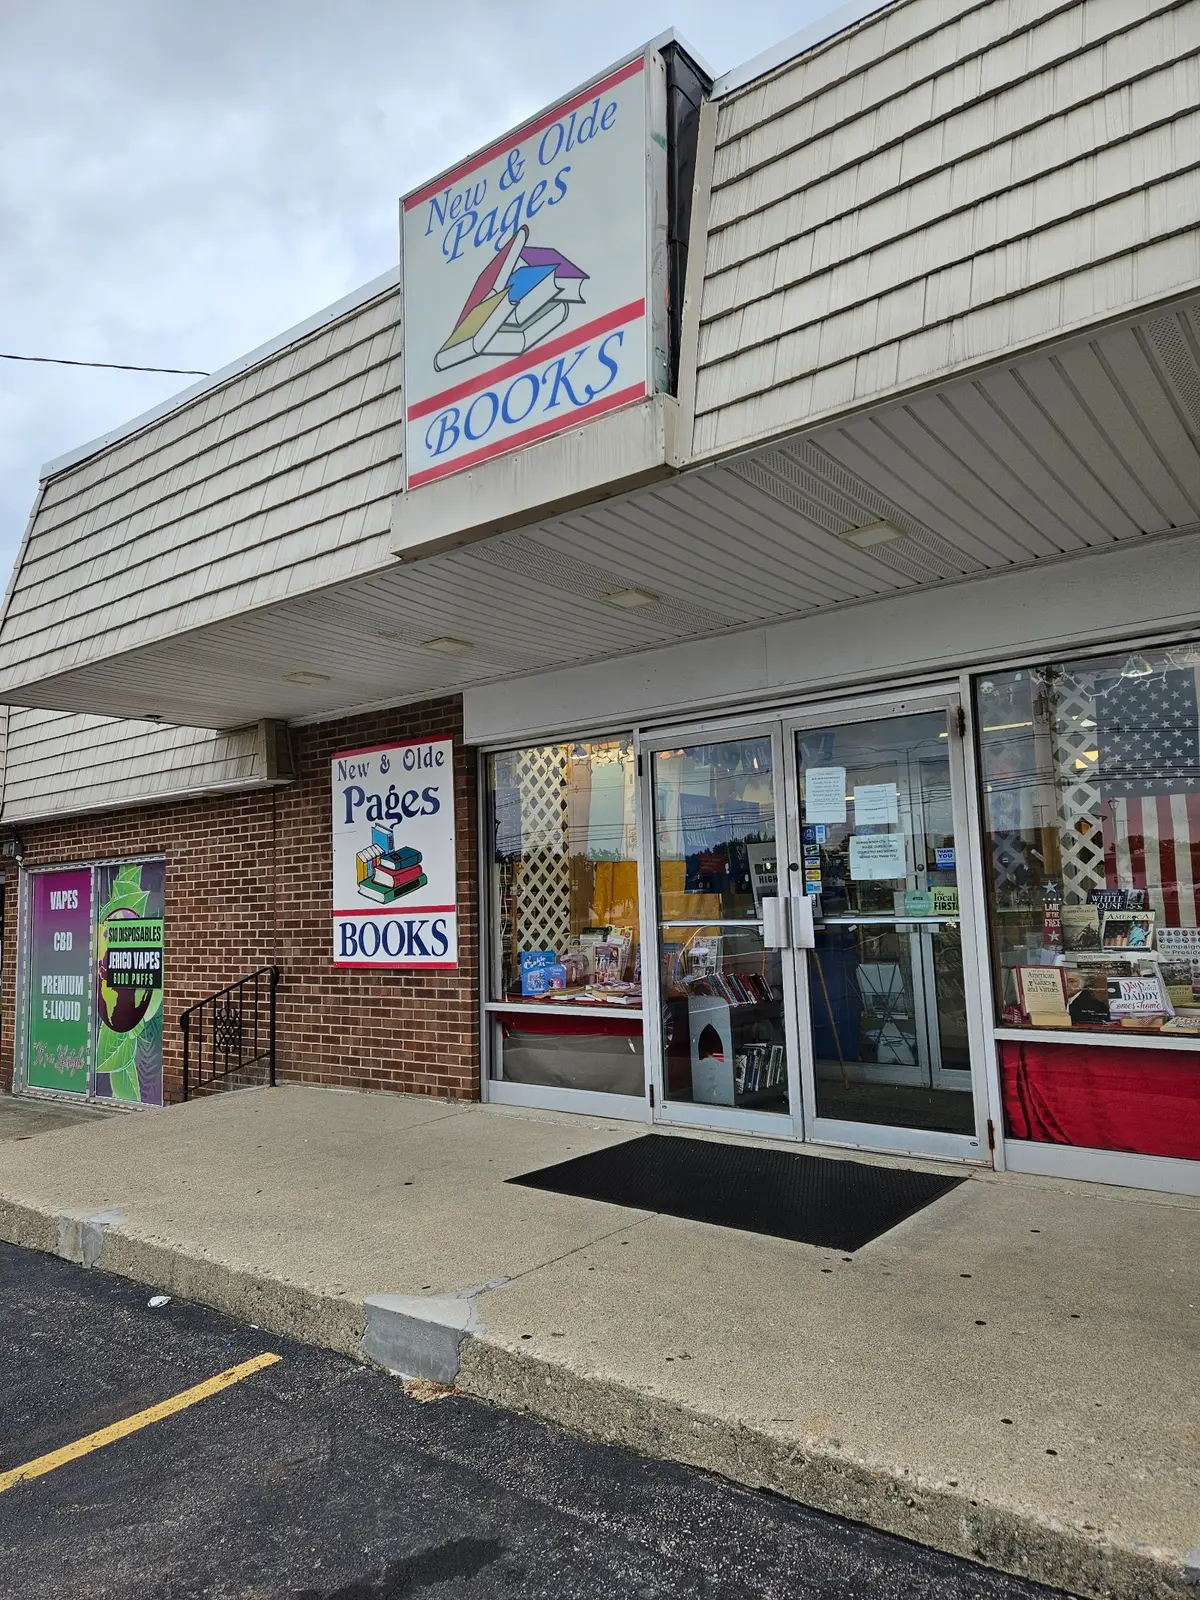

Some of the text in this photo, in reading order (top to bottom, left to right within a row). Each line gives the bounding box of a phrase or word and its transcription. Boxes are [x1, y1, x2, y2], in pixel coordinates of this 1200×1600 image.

[425, 98, 618, 236] New & Olde
[442, 165, 571, 264] Pages
[425, 330, 625, 458] BOOKS
[337, 745, 445, 781] New & Olde
[342, 784, 441, 829] Pages
[50, 890, 79, 910] VAPES
[934, 893, 956, 901] local
[934, 902, 956, 910] FIRST
[1091, 895, 1124, 903] WHITE
[1044, 919, 1061, 927] FREE
[53, 932, 73, 951] CBD
[119, 926, 161, 942] DISPOSABLES
[339, 918, 449, 957] BOOKS
[109, 951, 160, 969] JERICO VAPES
[131, 973, 154, 985] PUFFS
[1028, 971, 1055, 979] American
[41, 975, 84, 995] PREMIUM
[1038, 985, 1060, 993] Virtues
[1123, 992, 1158, 1000] DADDY
[42, 1000, 81, 1022] E-LIQUID
